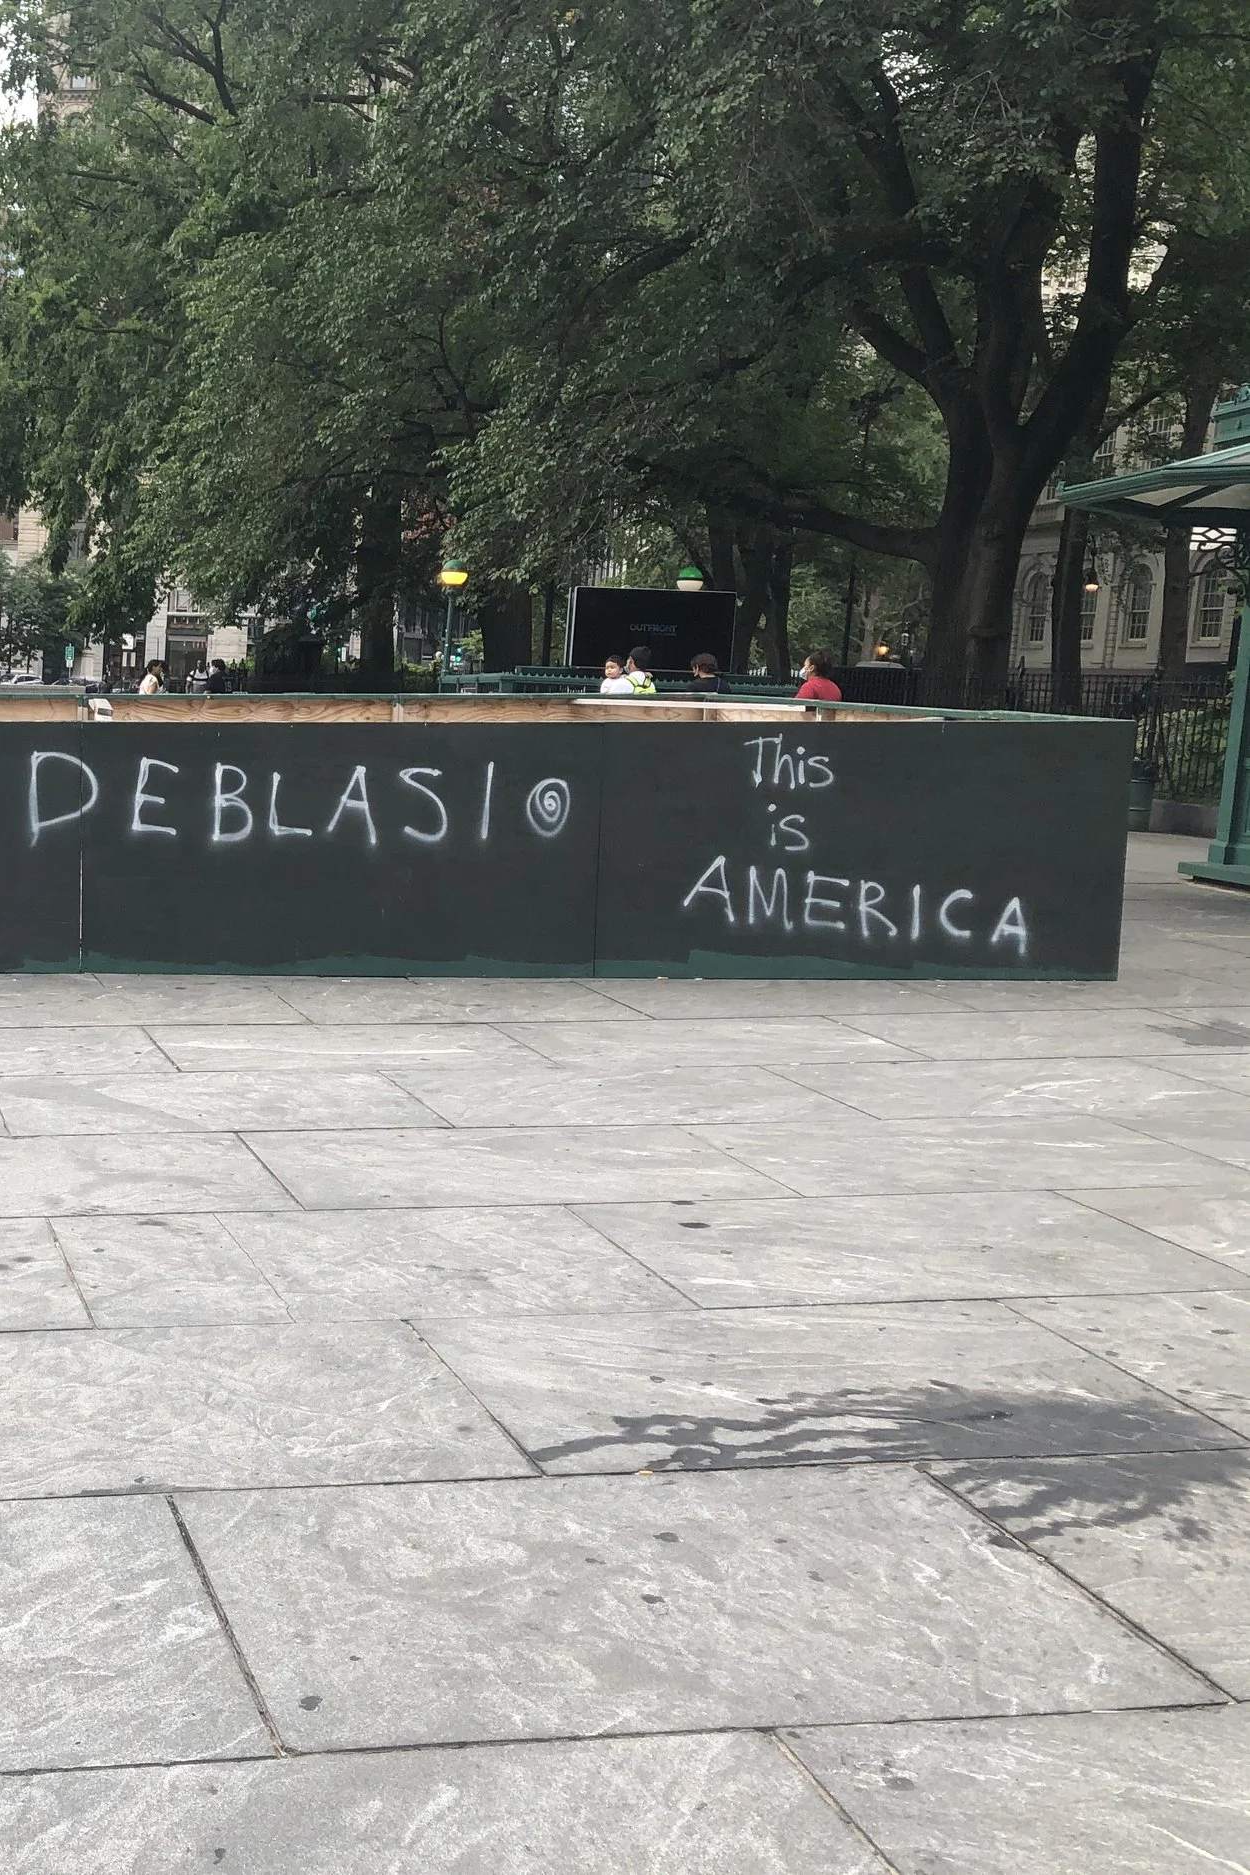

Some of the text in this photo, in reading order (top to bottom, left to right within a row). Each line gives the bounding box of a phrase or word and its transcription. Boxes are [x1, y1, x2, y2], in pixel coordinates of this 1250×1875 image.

[630, 624, 678, 632] OUTFRONT
[744, 733, 835, 788] This
[767, 803, 810, 851] is
[683, 855, 1029, 957] AMERICA
